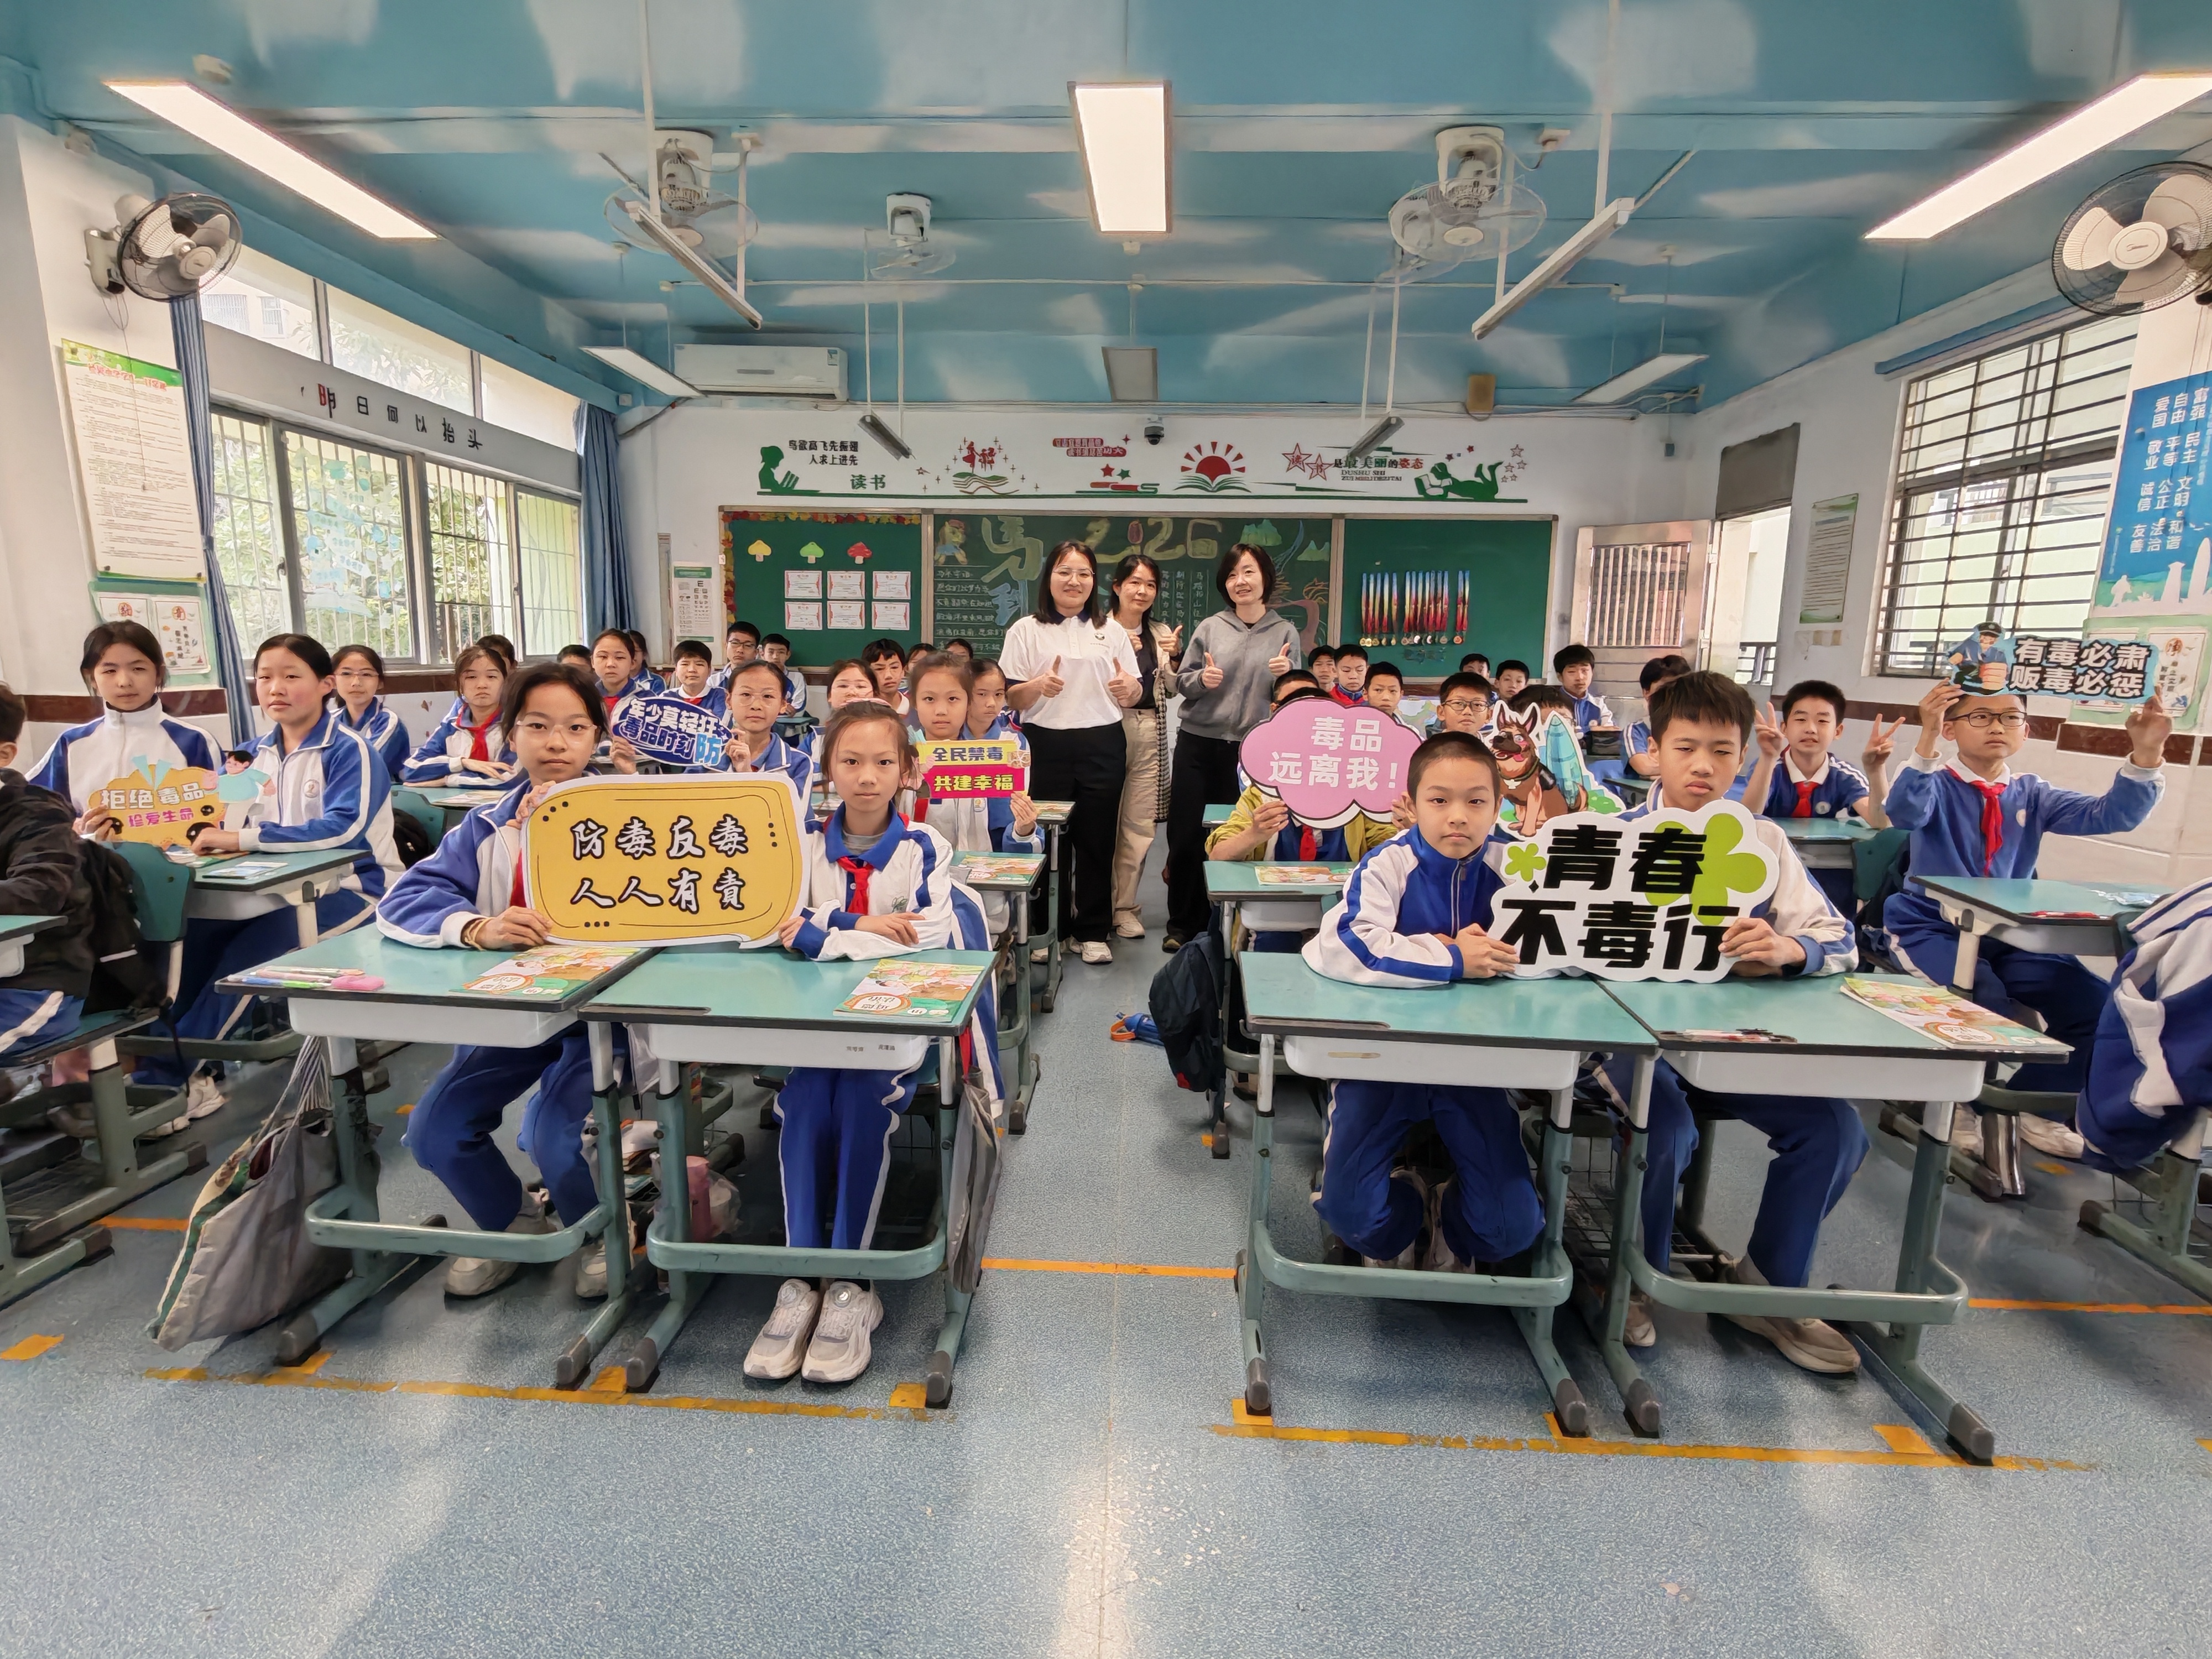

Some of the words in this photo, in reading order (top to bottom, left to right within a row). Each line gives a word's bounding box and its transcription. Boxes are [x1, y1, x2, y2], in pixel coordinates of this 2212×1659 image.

[851, 474, 886, 491] 读书
[2015, 638, 2150, 671] 有毒必肃
[2009, 665, 2145, 697] 贩毒必惩
[628, 698, 720, 736] 年少莫轻狂
[620, 714, 723, 765] 毒品时刻防
[1311, 717, 1383, 752] 毒品
[932, 747, 1004, 762] 全民禁毒
[101, 782, 205, 810] 拒绝毒品
[933, 774, 1014, 792] 共建幸福
[128, 807, 195, 828] 珍爱生命
[570, 813, 749, 860] 防毒反毒
[1543, 824, 1707, 895] 青春
[1498, 899, 1740, 972] 不毒行
